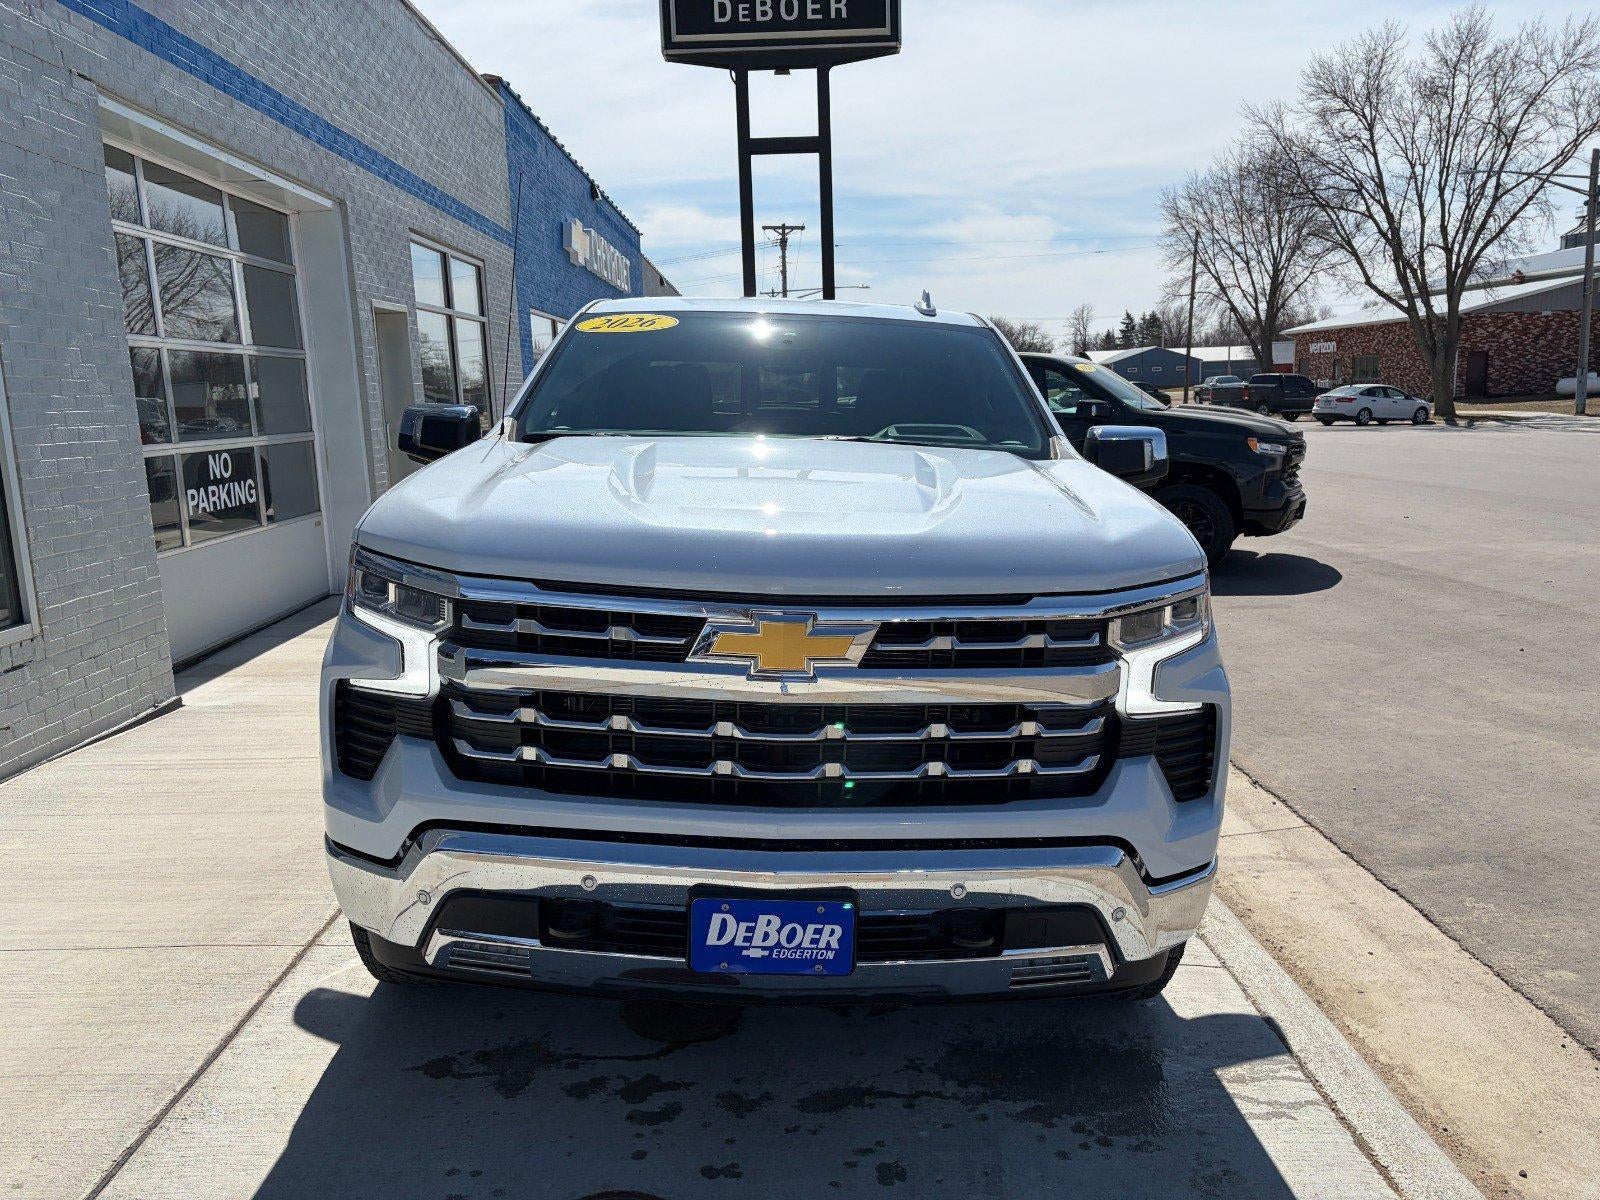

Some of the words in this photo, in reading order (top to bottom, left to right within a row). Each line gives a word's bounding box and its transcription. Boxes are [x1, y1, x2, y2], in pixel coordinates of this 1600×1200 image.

[588, 317, 662, 330] 2026
[1309, 339, 1337, 353] verizon
[208, 452, 232, 480] NO
[186, 479, 257, 516] PARKING
[772, 948, 835, 960] EDGERTON
